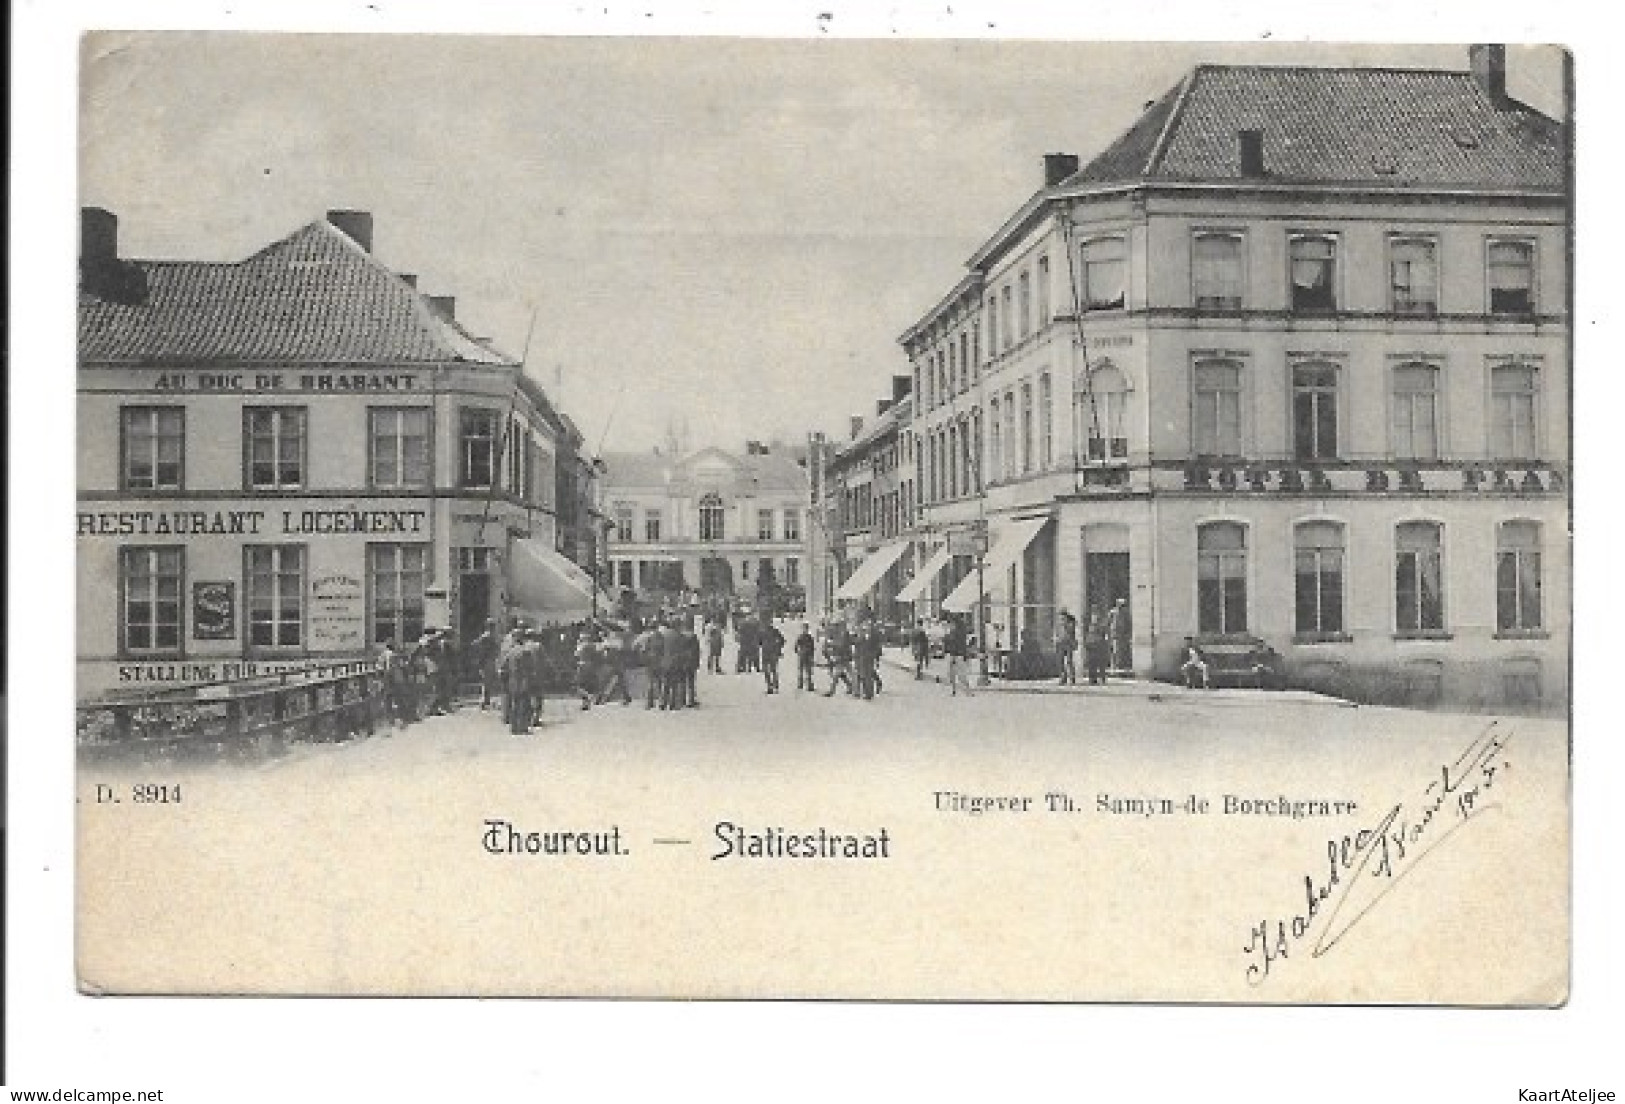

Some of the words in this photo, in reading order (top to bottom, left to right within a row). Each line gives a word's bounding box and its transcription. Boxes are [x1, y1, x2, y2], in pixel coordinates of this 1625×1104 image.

[155, 375, 186, 390] AU
[200, 375, 243, 390] DUC
[256, 375, 284, 390] DE
[301, 375, 417, 390] BRABANT
[1184, 469, 1332, 492] HOTEL
[77, 511, 265, 535] RESTAURANT
[132, 783, 181, 803] 8914
[933, 792, 1033, 815] Uitgever
[1045, 793, 1082, 813] Th.
[1222, 795, 1358, 821] Borchgrave
[482, 819, 630, 856] Thourout.
[710, 821, 891, 860] Statiestraat
